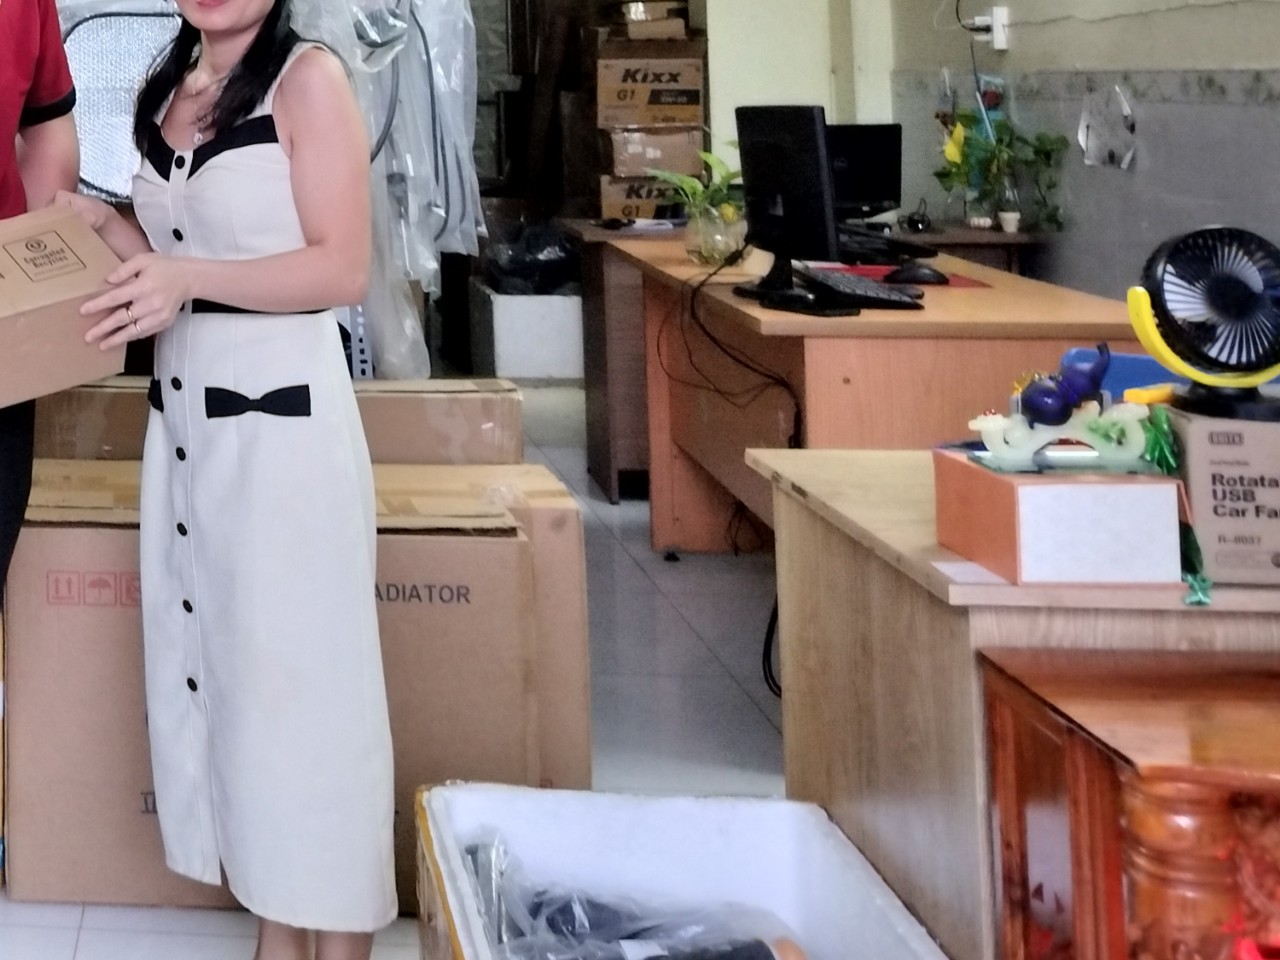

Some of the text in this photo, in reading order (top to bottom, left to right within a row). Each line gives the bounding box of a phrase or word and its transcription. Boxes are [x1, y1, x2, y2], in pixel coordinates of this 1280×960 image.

[621, 68, 681, 84] Kixx
[616, 90, 636, 101] G1
[621, 204, 641, 218] G1
[23, 247, 67, 265] Corrugated
[1212, 488, 1256, 503] USB
[1212, 504, 1248, 518] Car
[375, 583, 471, 605] ADIATOR
